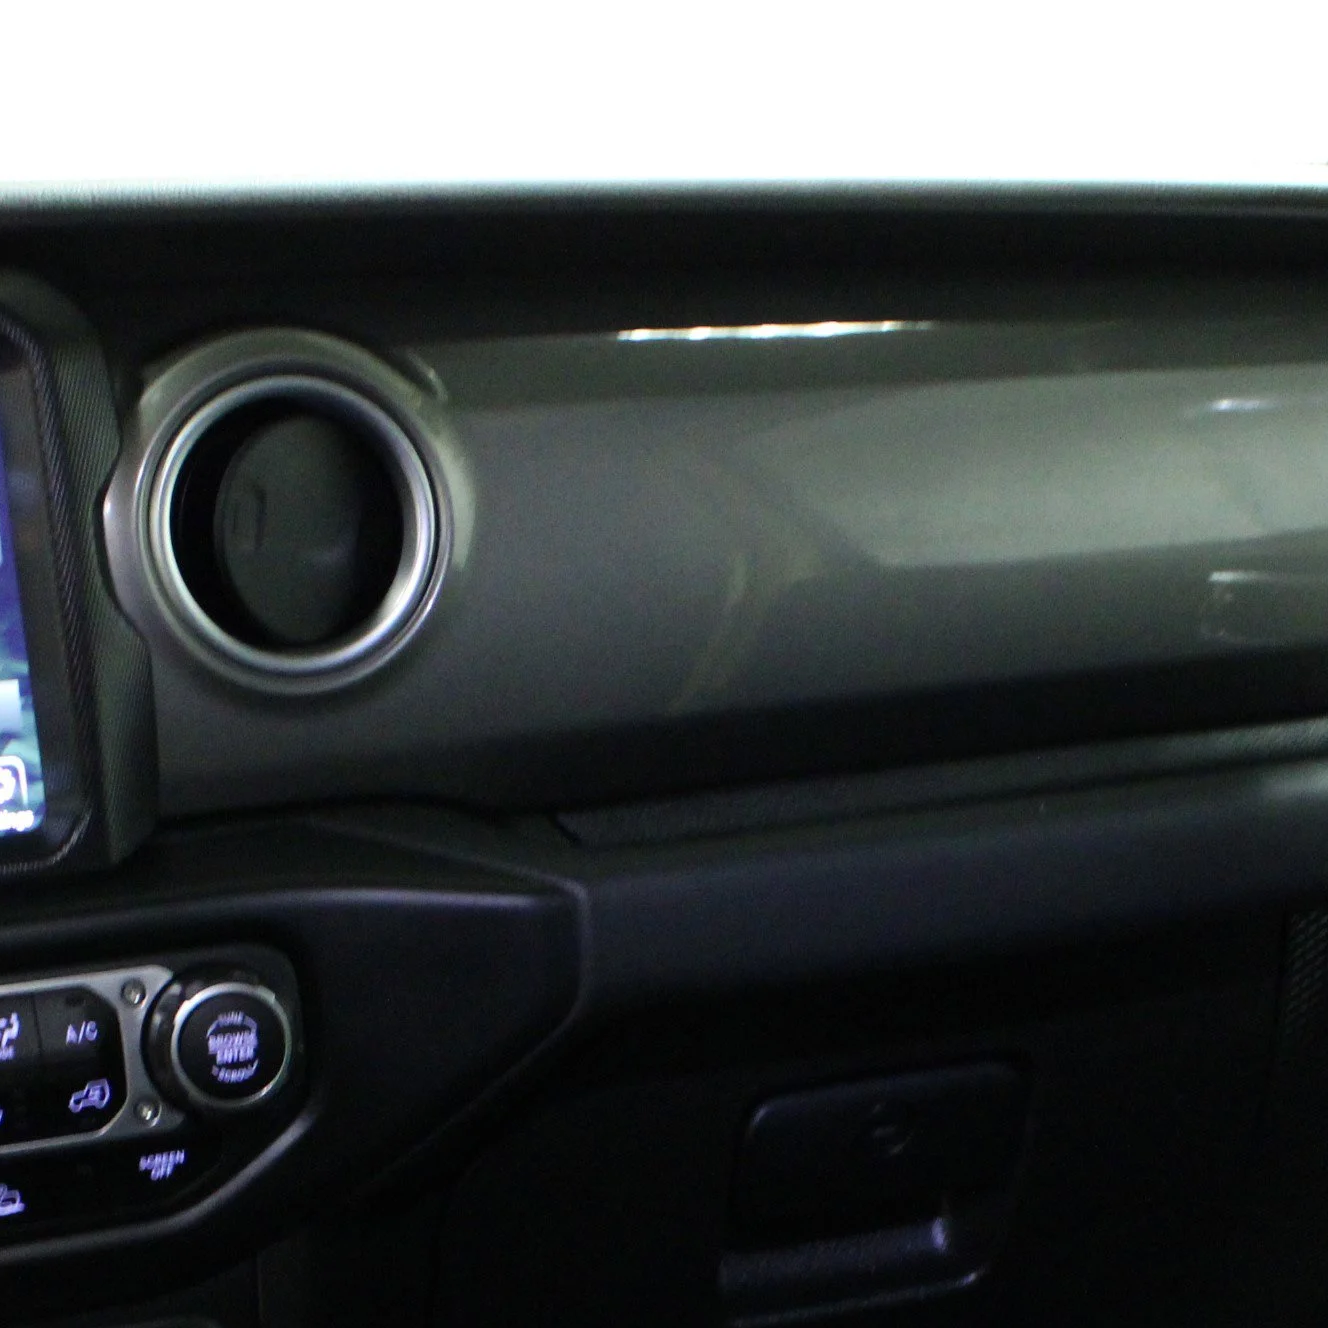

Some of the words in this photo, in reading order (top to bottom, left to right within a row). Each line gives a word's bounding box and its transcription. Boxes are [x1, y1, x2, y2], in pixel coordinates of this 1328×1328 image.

[65, 1020, 99, 1045] A/C
[207, 1031, 259, 1054] BROWSE
[215, 1046, 255, 1065] ENTER
[138, 1147, 186, 1173] SCREEN
[150, 1161, 173, 1182] OFF
